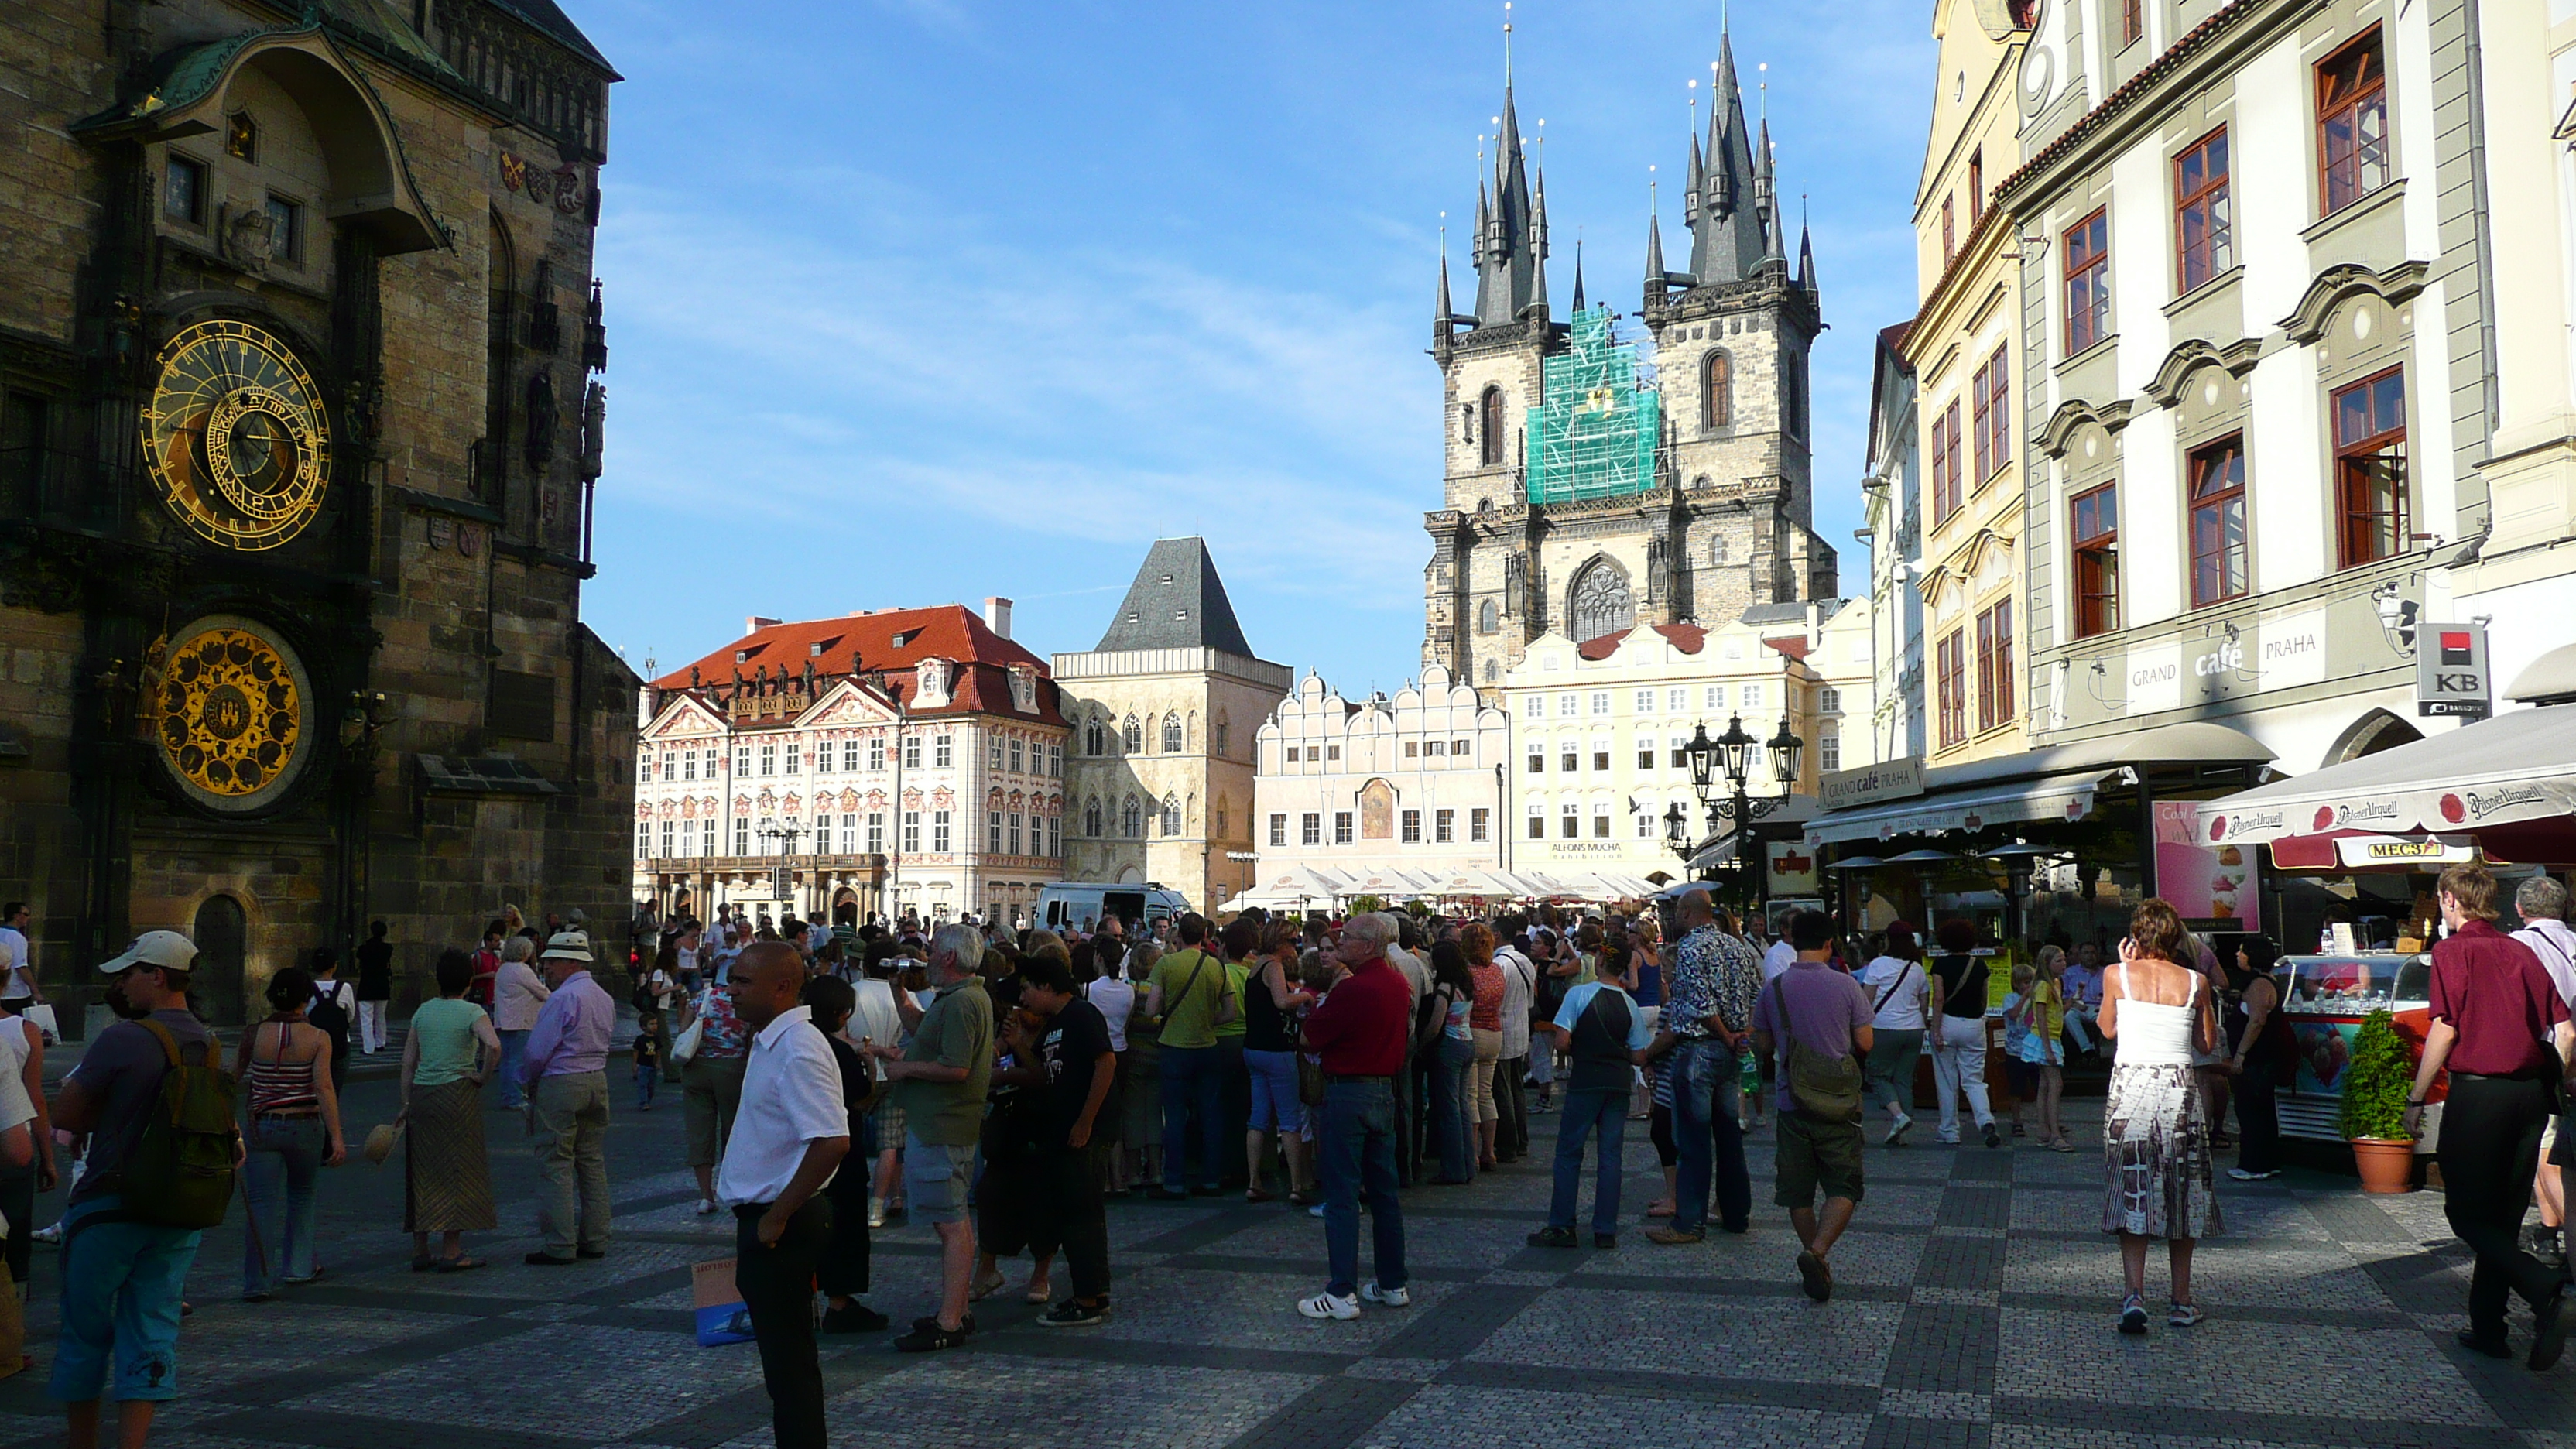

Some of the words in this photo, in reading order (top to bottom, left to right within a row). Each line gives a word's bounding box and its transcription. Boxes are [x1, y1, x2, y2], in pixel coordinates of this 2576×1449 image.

[2132, 664, 2177, 687] GRAND
[2195, 640, 2243, 677] café
[2266, 633, 2317, 660] PRAHA
[2434, 673, 2479, 693] KB
[1828, 780, 1856, 798] GRAND
[1857, 770, 1879, 793] café
[1880, 769, 1911, 790] PRAHA
[2366, 800, 2397, 820] Urquell
[2466, 791, 2503, 820] Pilsner
[2499, 786, 2542, 805] Urquell
[2162, 807, 2187, 820] Cool
[2228, 815, 2257, 840] Pilsner
[2256, 811, 2283, 830] Urquell
[1552, 843, 1586, 851] ALFONS
[1588, 842, 1622, 851] MUCHA
[2374, 843, 2423, 856] MEC3
